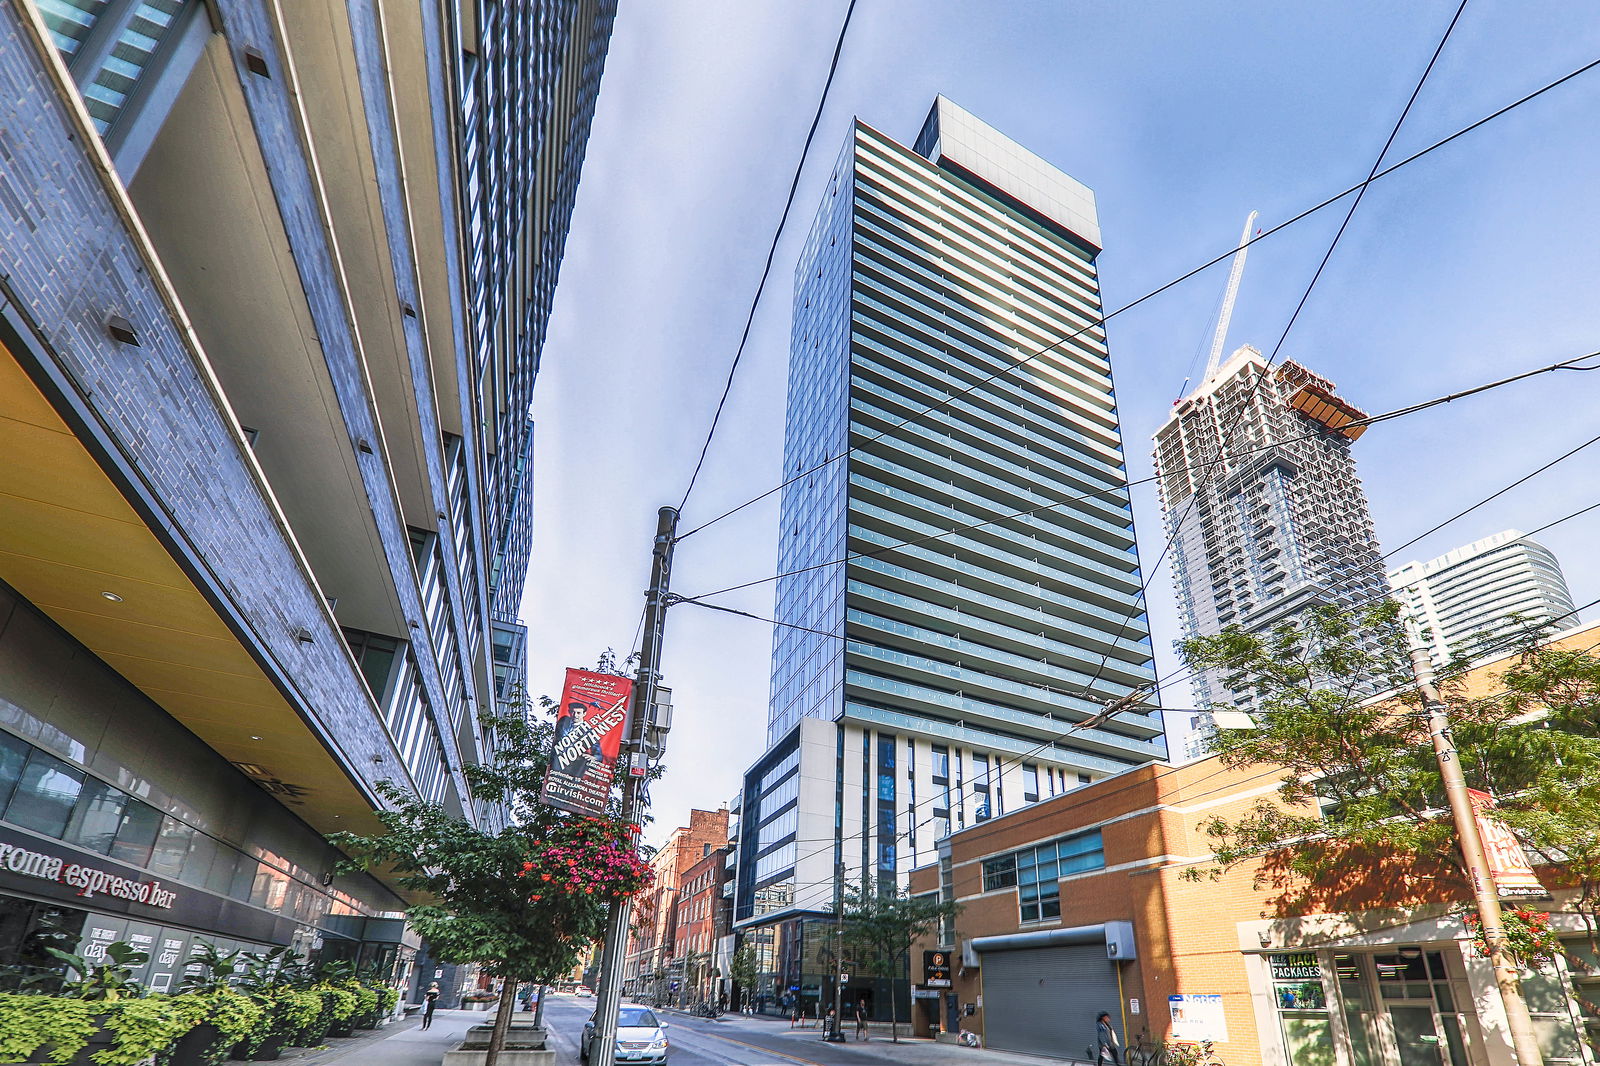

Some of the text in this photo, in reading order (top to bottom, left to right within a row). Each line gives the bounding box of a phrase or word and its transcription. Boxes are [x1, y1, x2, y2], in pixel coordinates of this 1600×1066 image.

[554, 714, 603, 755] NORTH BY
[558, 705, 627, 770] NORTHWEST
[550, 770, 574, 781] September
[546, 781, 604, 808] mirvish.com
[65, 864, 149, 898] espresso
[149, 881, 176, 909] bar
[159, 949, 179, 968] day
[1272, 966, 1321, 978] PACKAGES
[1184, 995, 1222, 1004] Notice
